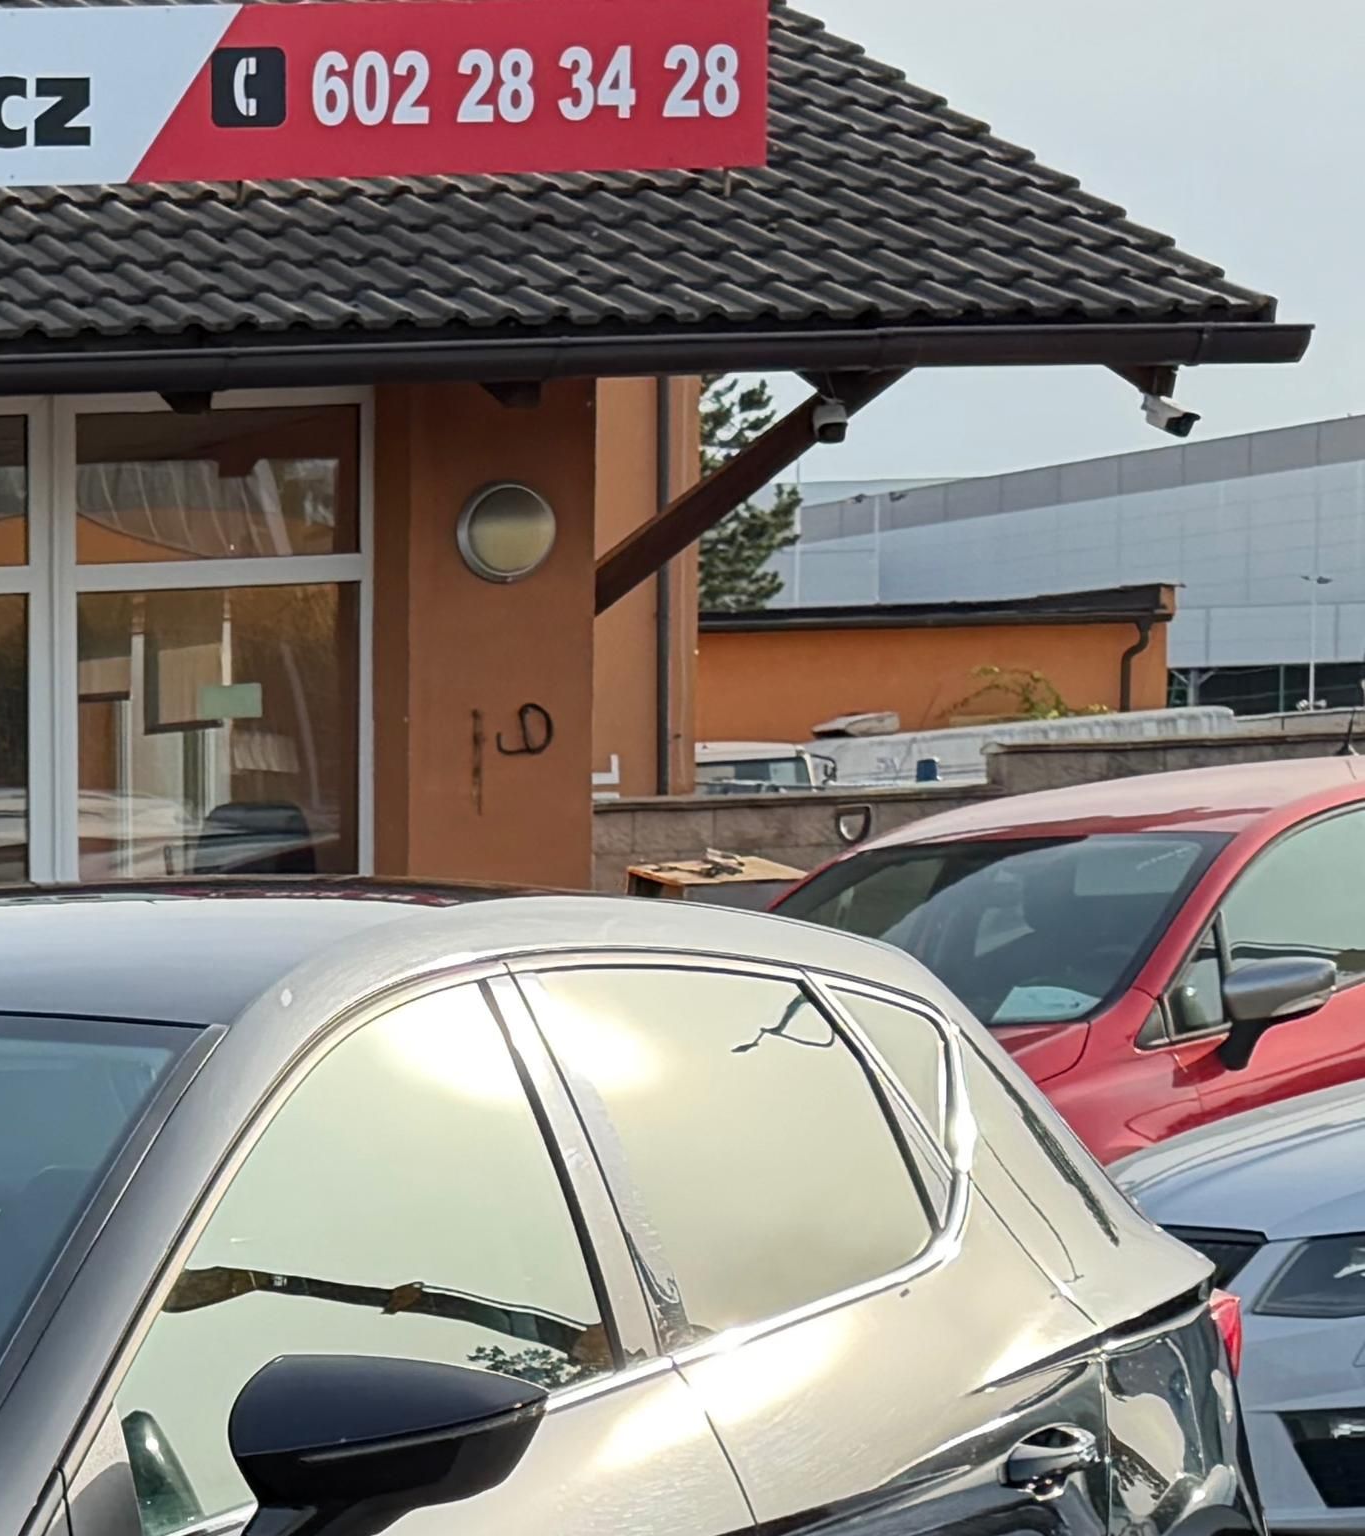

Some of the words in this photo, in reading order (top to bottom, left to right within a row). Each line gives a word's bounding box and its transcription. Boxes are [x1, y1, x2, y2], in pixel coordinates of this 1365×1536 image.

[312, 49, 430, 126] 602
[457, 48, 534, 123] 28
[558, 45, 636, 119] 34
[662, 44, 740, 118] 28
